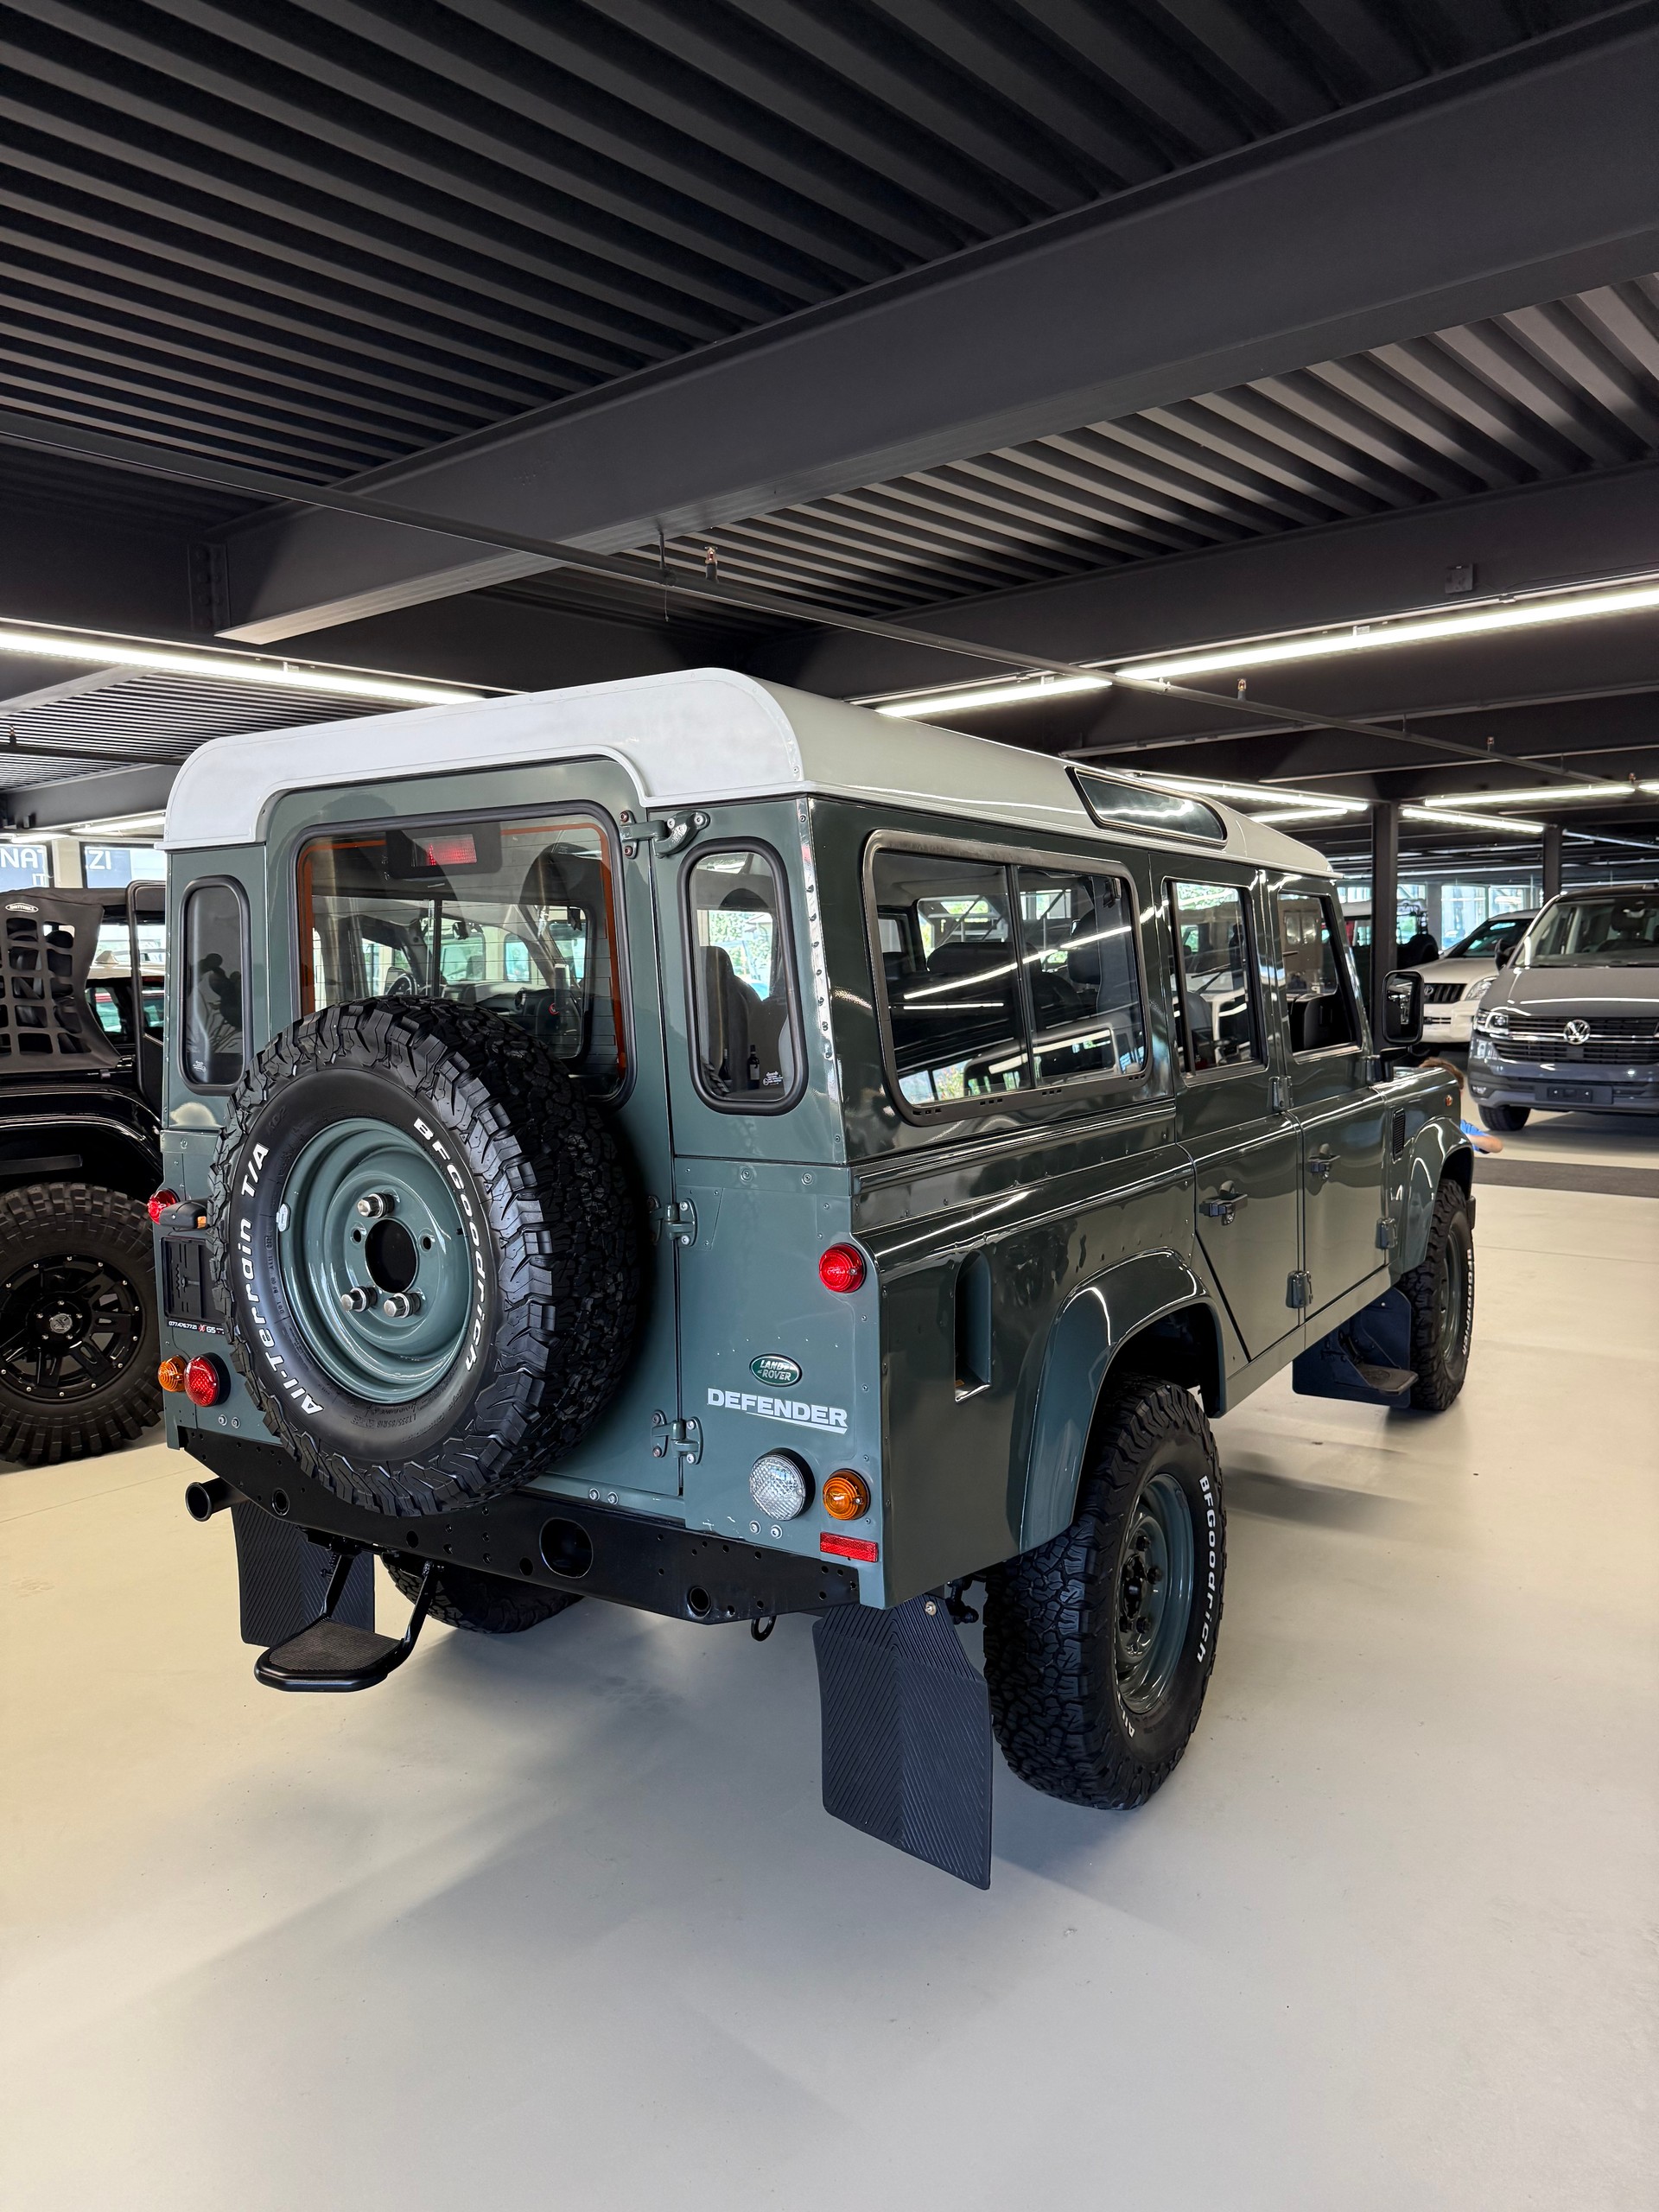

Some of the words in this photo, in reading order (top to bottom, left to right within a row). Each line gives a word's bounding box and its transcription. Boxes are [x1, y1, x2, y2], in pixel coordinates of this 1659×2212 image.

[85, 849, 111, 870] ZI
[240, 1143, 270, 1198] T/A
[413, 1117, 486, 1371] BFGoodrich
[238, 1218, 324, 1414] All-Terrain
[760, 1360, 782, 1370] LAND
[762, 1369, 791, 1381] ROVER
[708, 1388, 848, 1427] DEFENDER
[1198, 1475, 1216, 1662] BFGoodrich
